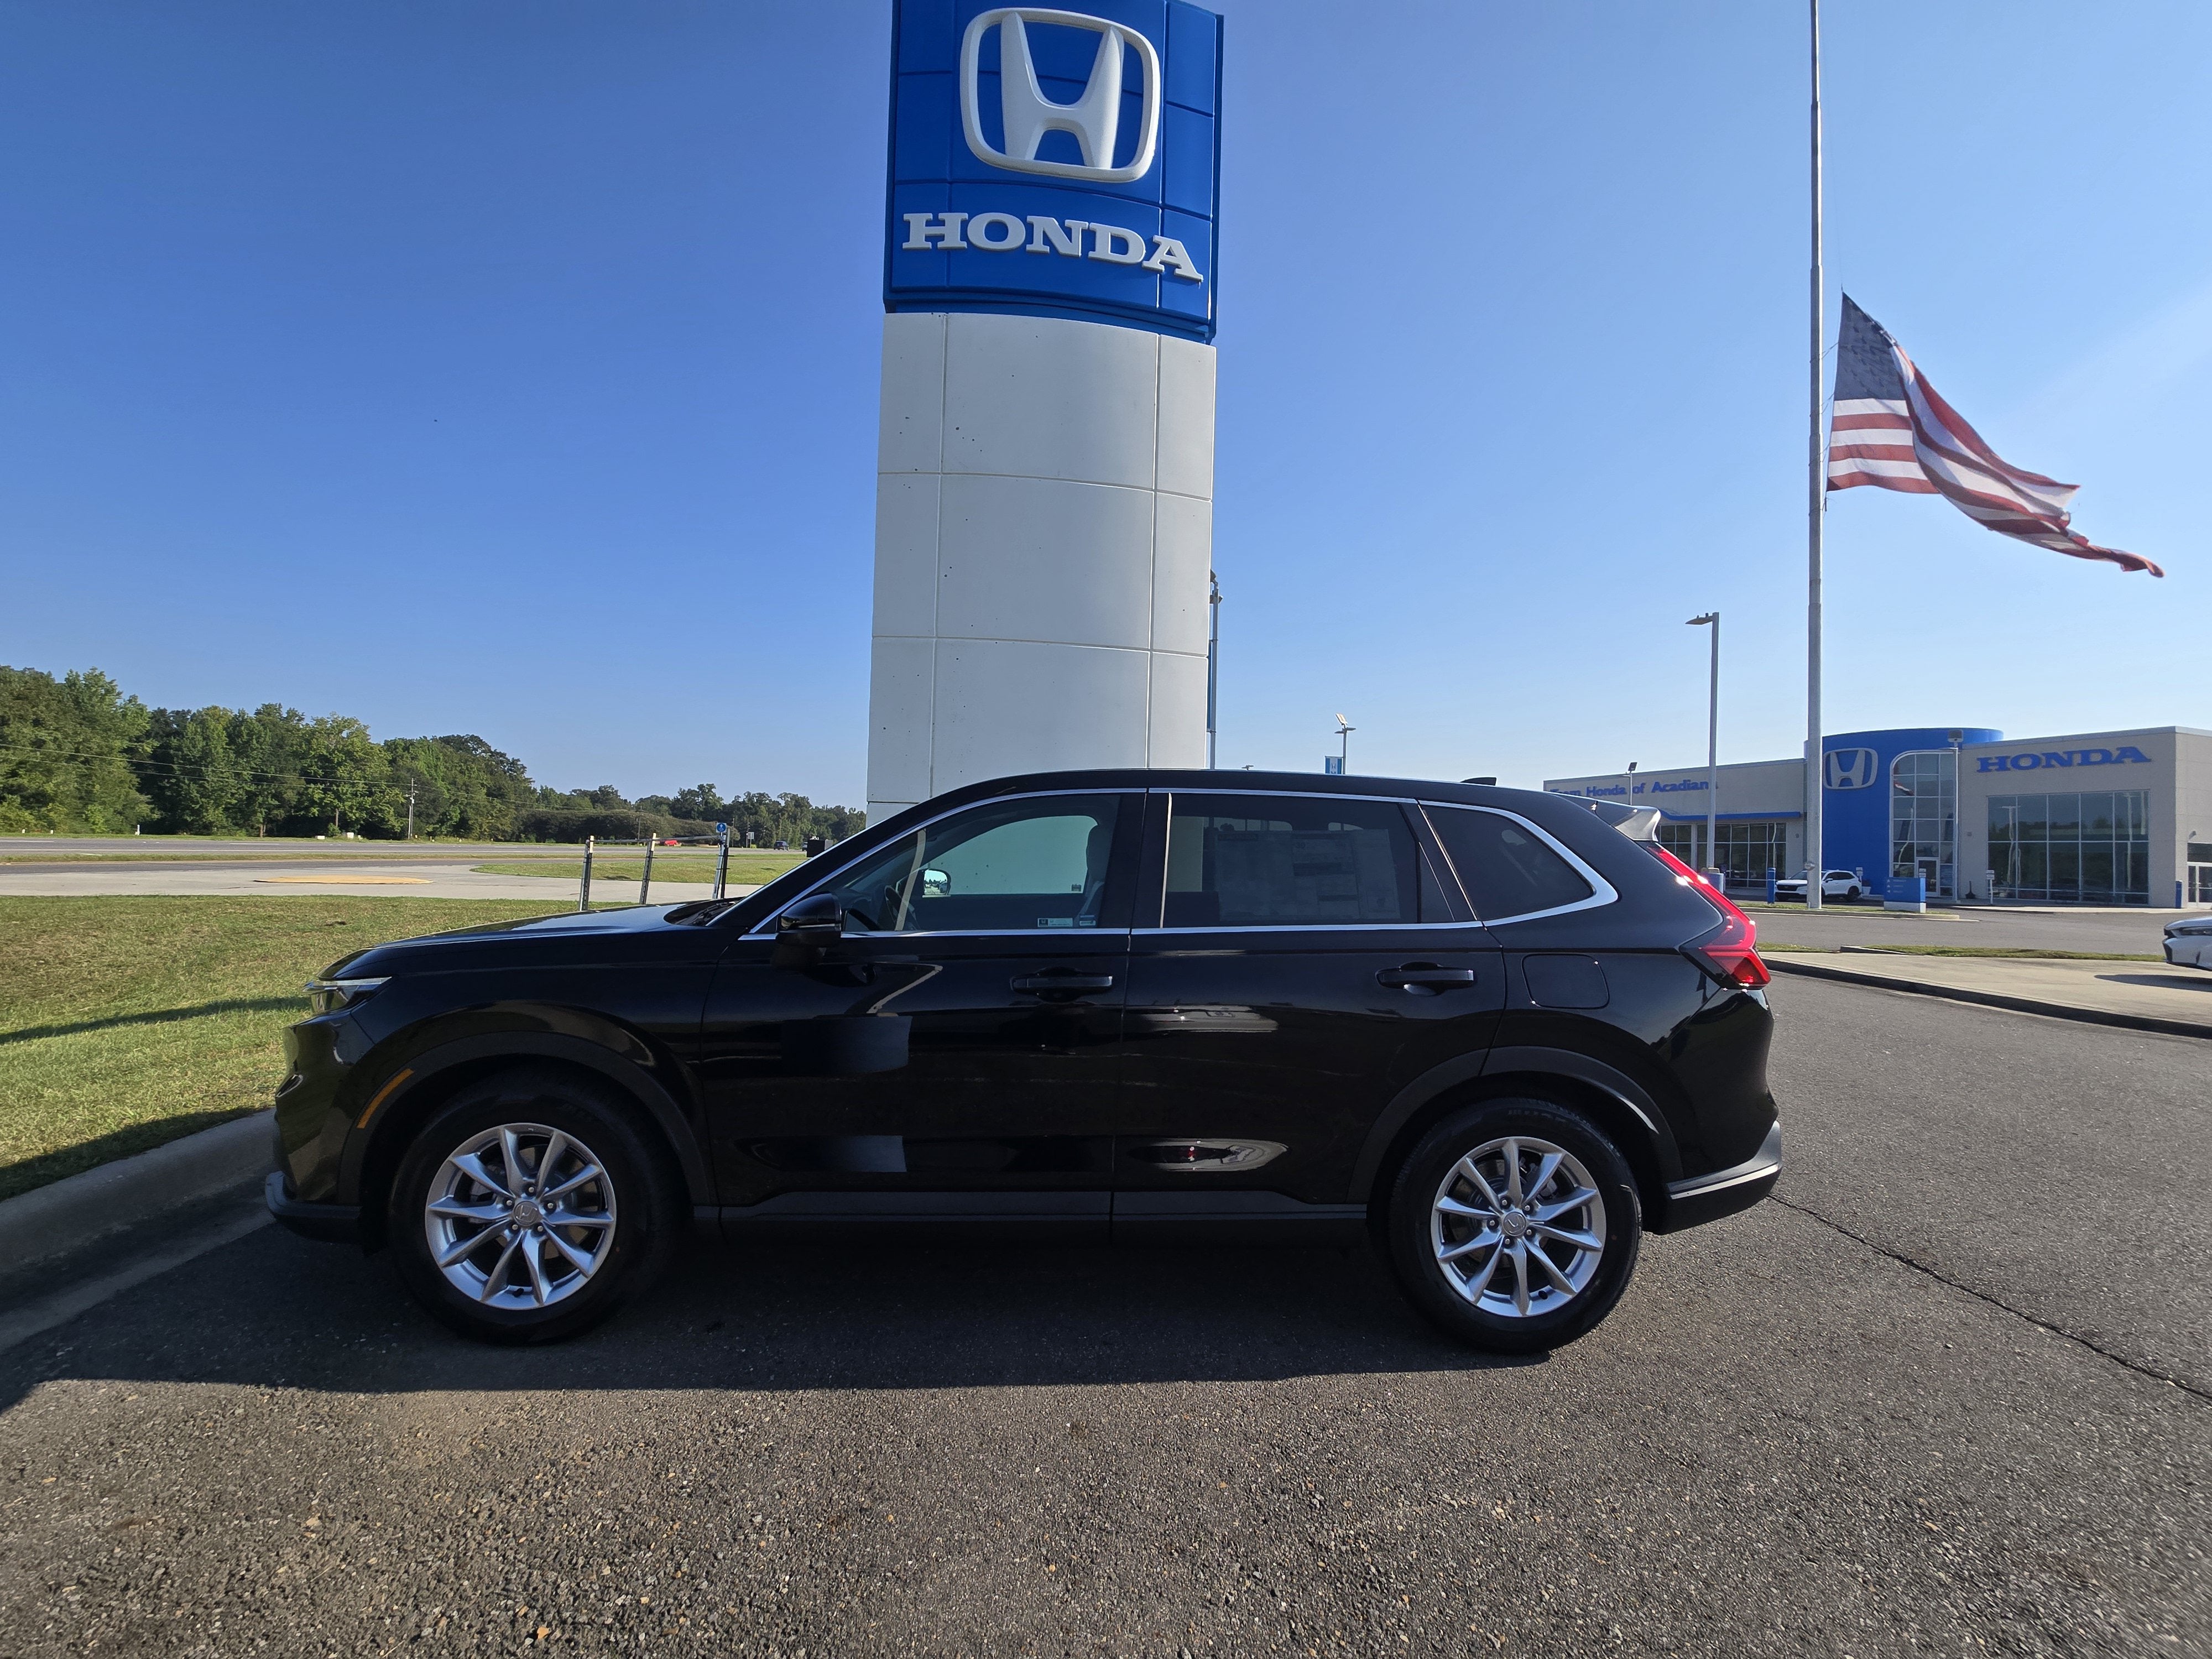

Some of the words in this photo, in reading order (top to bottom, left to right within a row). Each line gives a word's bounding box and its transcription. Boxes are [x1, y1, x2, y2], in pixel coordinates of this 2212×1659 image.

[901, 212, 1204, 283] HONDA
[1976, 746, 2152, 773] HONDA
[1586, 784, 1627, 797] Honda
[1632, 782, 1646, 794] of
[1651, 779, 1719, 793] Acadian
